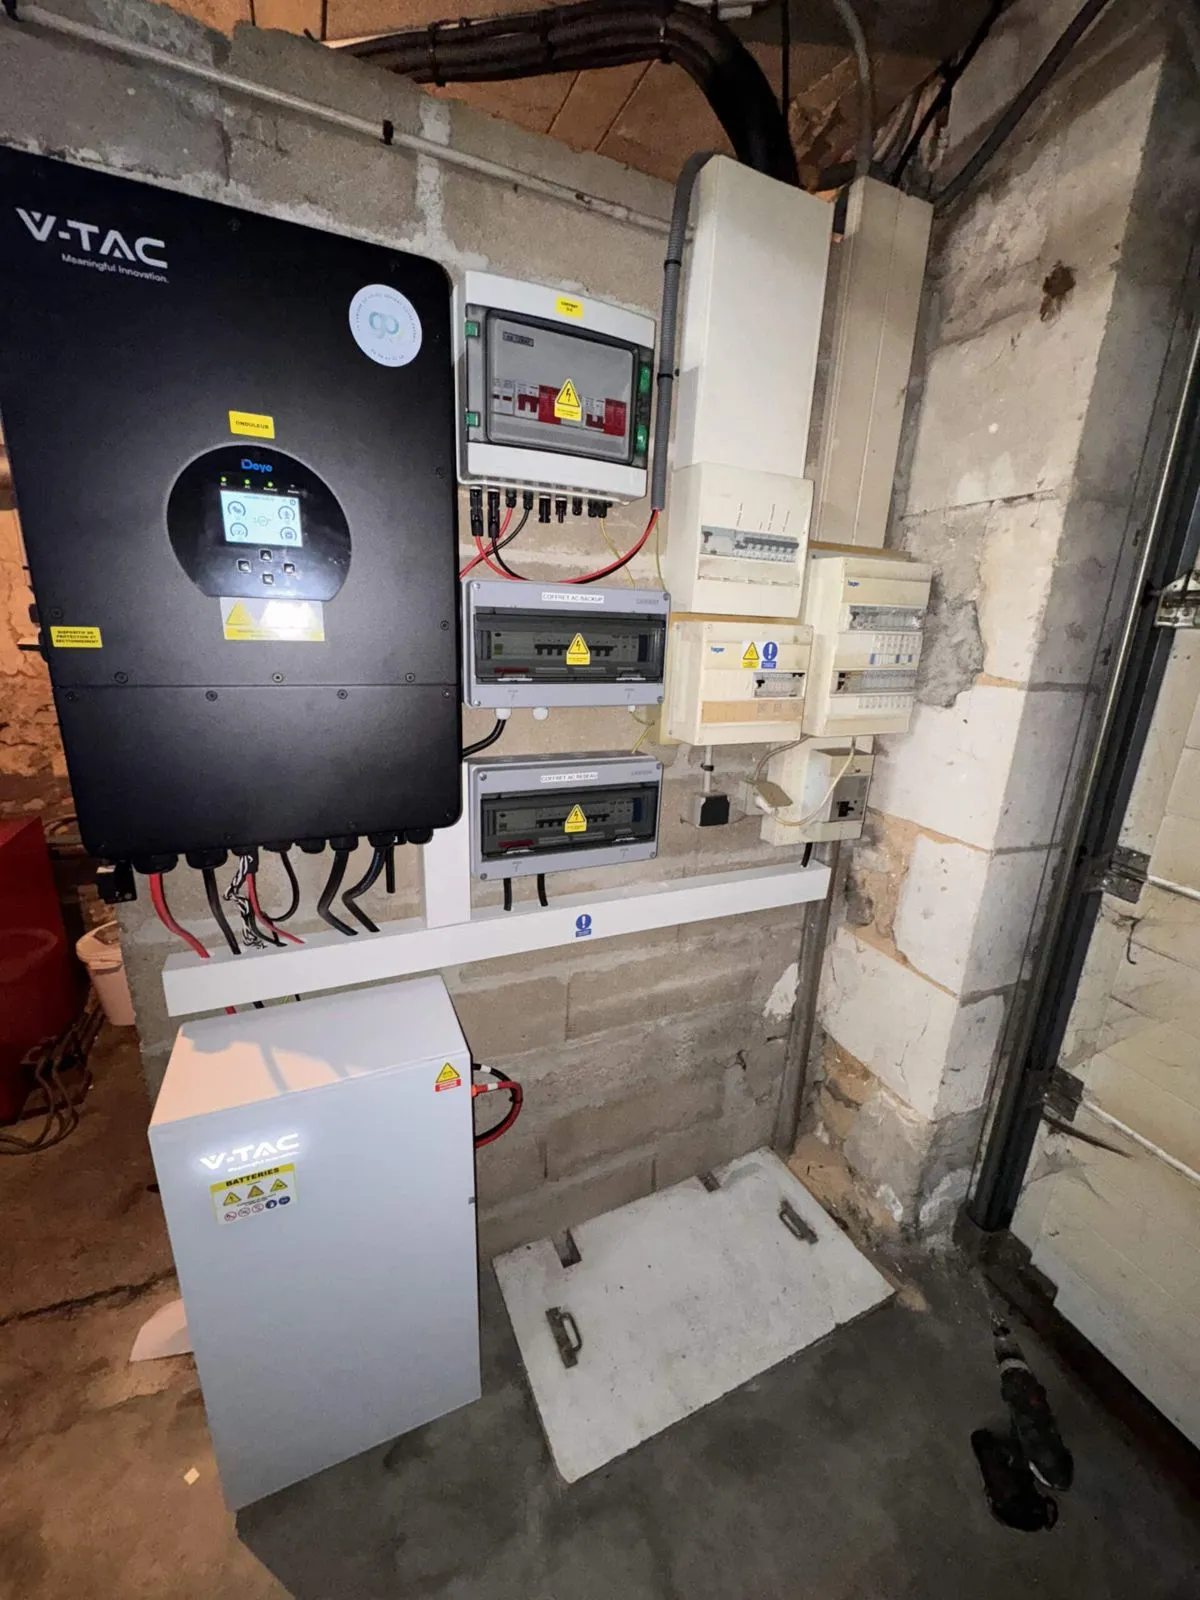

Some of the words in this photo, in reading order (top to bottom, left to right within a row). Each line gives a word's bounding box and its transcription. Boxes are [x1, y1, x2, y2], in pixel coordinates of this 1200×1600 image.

[15, 207, 168, 269] V-TAC
[61, 253, 116, 272] Meaningful
[200, 1132, 299, 1170] V-TAC
[226, 1167, 280, 1187] BATTERIES
